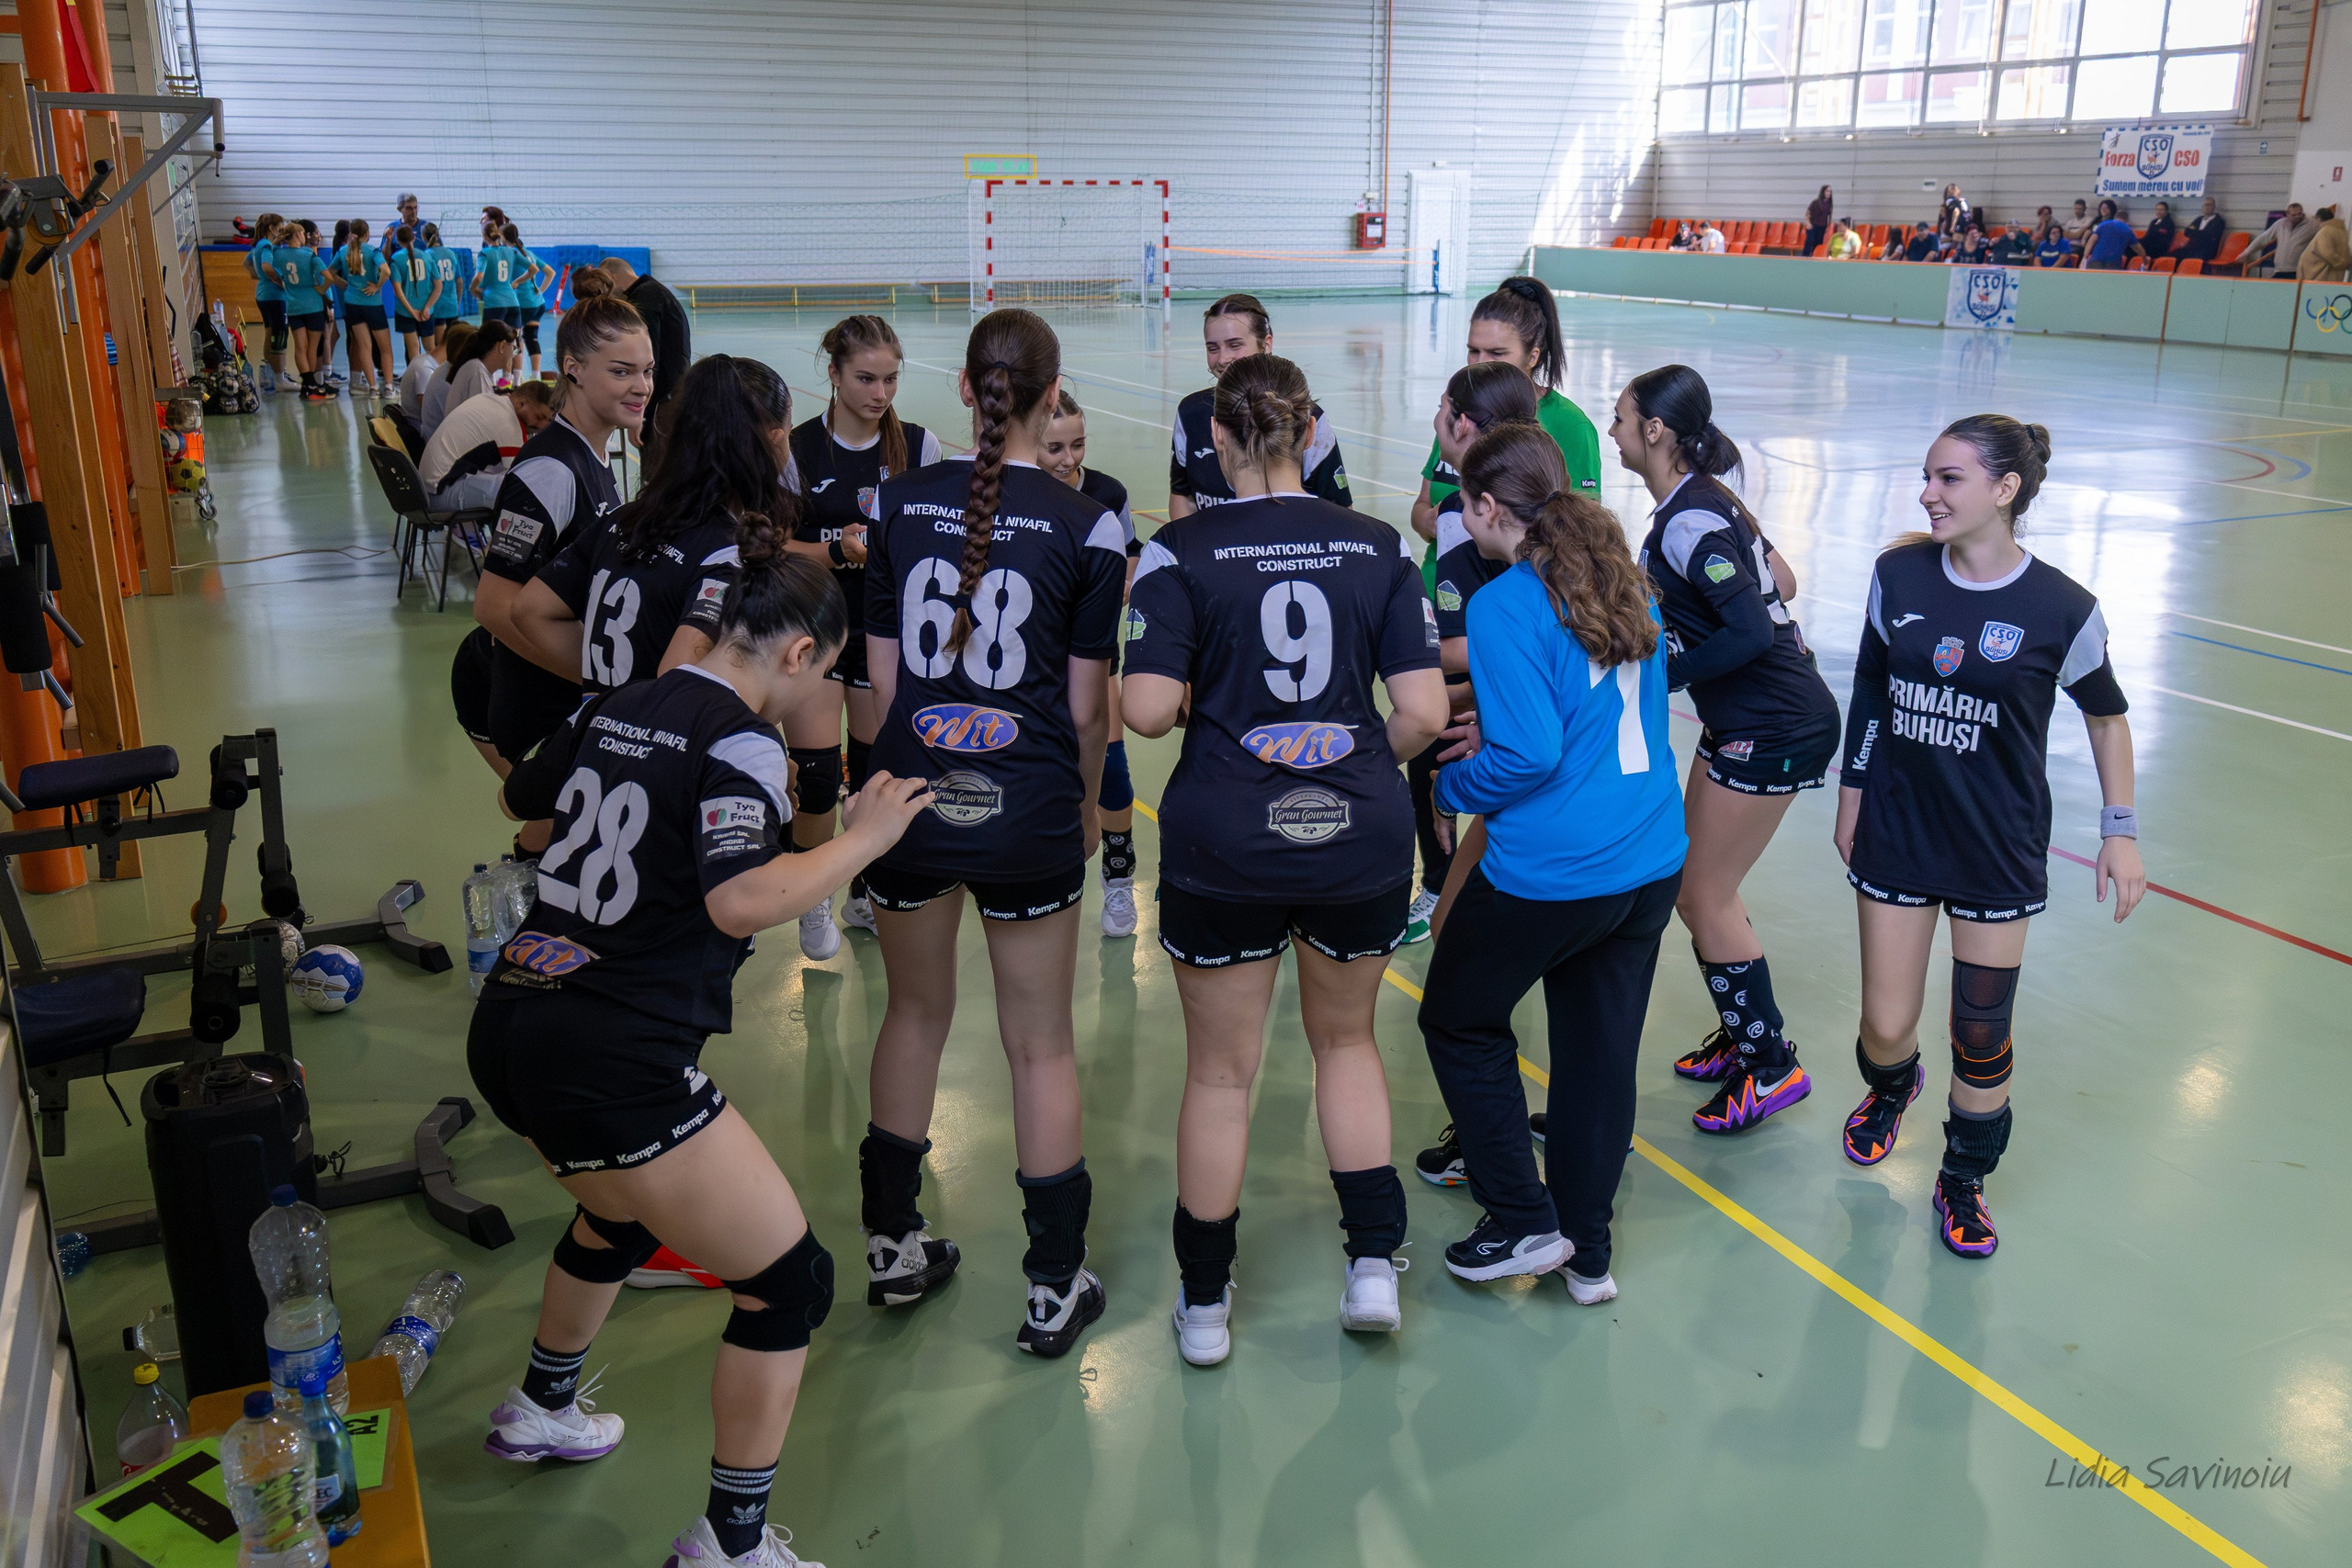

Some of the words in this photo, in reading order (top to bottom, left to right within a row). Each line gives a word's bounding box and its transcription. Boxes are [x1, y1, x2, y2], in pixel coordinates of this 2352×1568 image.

[2143, 139, 2168, 152] CSO
[2104, 151, 2136, 167] Forza
[2174, 149, 2200, 167] CSO
[2103, 179, 2136, 191] Suntem
[2138, 181, 2168, 191] mereu
[2171, 181, 2184, 191] cu
[2186, 179, 2204, 191] voi!
[286, 262, 300, 285] 3
[437, 258, 453, 281] 13
[497, 259, 509, 282] 6
[1973, 276, 2001, 289] CSO
[1005, 515, 1053, 533] NIVAFIL
[1214, 543, 1324, 560] INTERNATIONAL
[1329, 542, 1377, 556] NIVAFIL
[1257, 557, 1342, 572] CONSTRUCT
[582, 569, 641, 687] 13
[902, 557, 1034, 689] 68
[1261, 581, 1332, 703] 9
[1989, 627, 2016, 641] CSO
[1889, 673, 1998, 728] PRIMĂRIA
[919, 708, 1007, 747] Wit
[1892, 707, 1980, 754] BUHUȘI
[1249, 724, 1340, 763] Wit
[1851, 719, 1880, 771] Kempa
[1728, 777, 1758, 792] Kempa
[1766, 784, 1792, 793] Kempa
[735, 802, 755, 812] Tya
[956, 791, 996, 805] Gourmet
[730, 813, 760, 823] Fruct
[1274, 809, 1299, 823] Gran
[1301, 808, 1342, 823] Gourmet
[537, 766, 650, 926] 28
[707, 844, 745, 856] CONSTRUCT
[1861, 882, 1889, 899] Kempa
[1897, 894, 1927, 905] Kempa
[983, 908, 1017, 919] Kempa
[1027, 901, 1060, 917] Kempa
[1951, 906, 1977, 919] Kempa
[1985, 908, 2018, 919] Kempa
[1163, 937, 1185, 959] Kempa
[1195, 955, 1230, 965] Kempa
[1240, 948, 1272, 958] Kempa
[1308, 935, 1337, 957] Kempa
[616, 1141, 662, 1165] Kempa
[672, 1108, 709, 1139] Kempa
